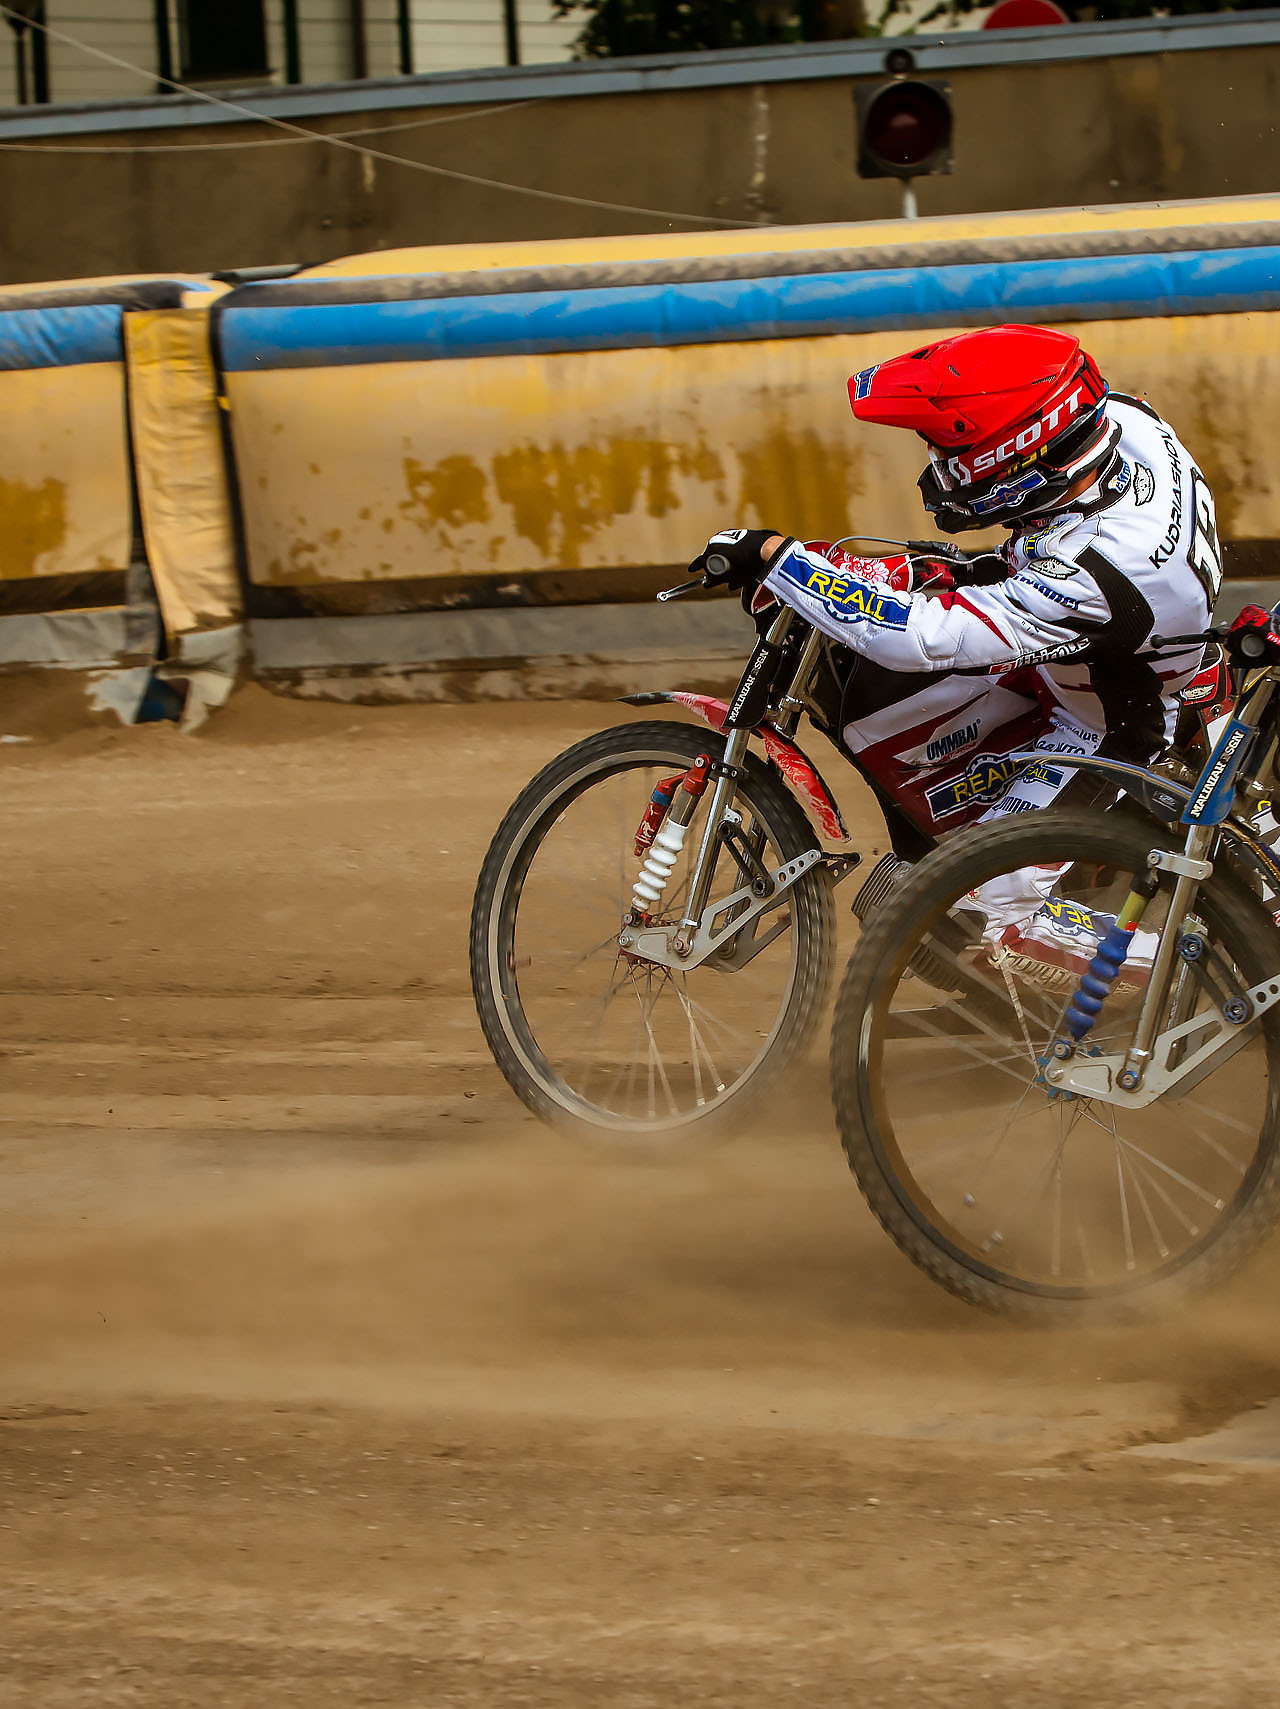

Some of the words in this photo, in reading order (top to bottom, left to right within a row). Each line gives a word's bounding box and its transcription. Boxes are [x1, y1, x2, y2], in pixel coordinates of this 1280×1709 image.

[973, 386, 1083, 474] SCOTT
[806, 571, 885, 621] REALL
[1190, 760, 1227, 818] MALINIAK
